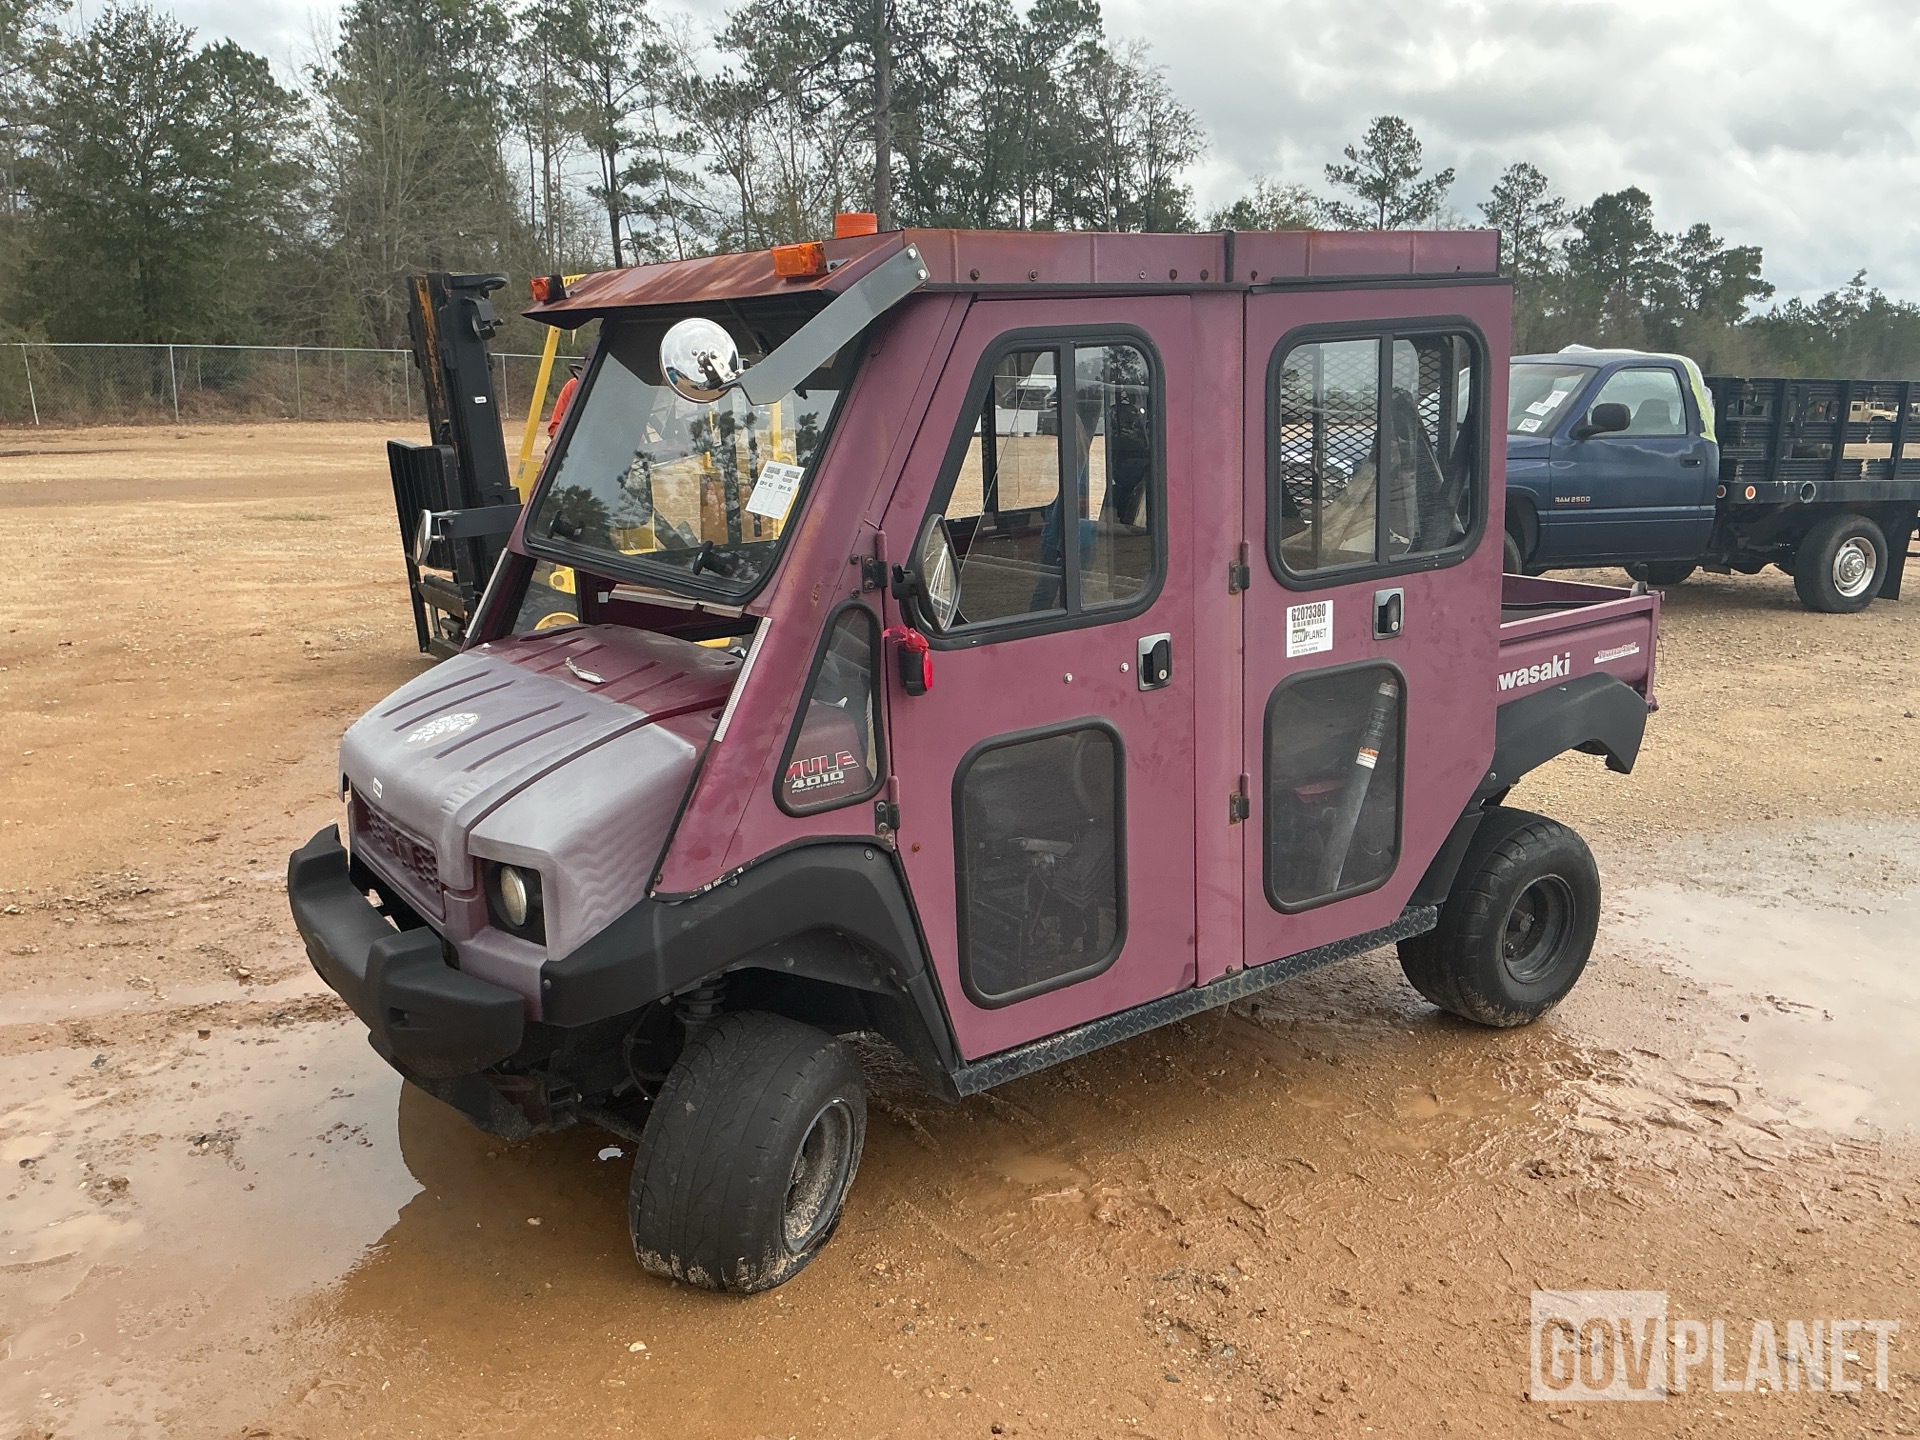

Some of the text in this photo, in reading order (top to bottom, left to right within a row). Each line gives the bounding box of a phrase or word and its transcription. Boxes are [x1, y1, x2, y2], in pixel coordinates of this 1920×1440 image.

[1497, 652, 1570, 691] wasaki
[785, 751, 859, 783] MULE
[791, 771, 844, 789] 4010
